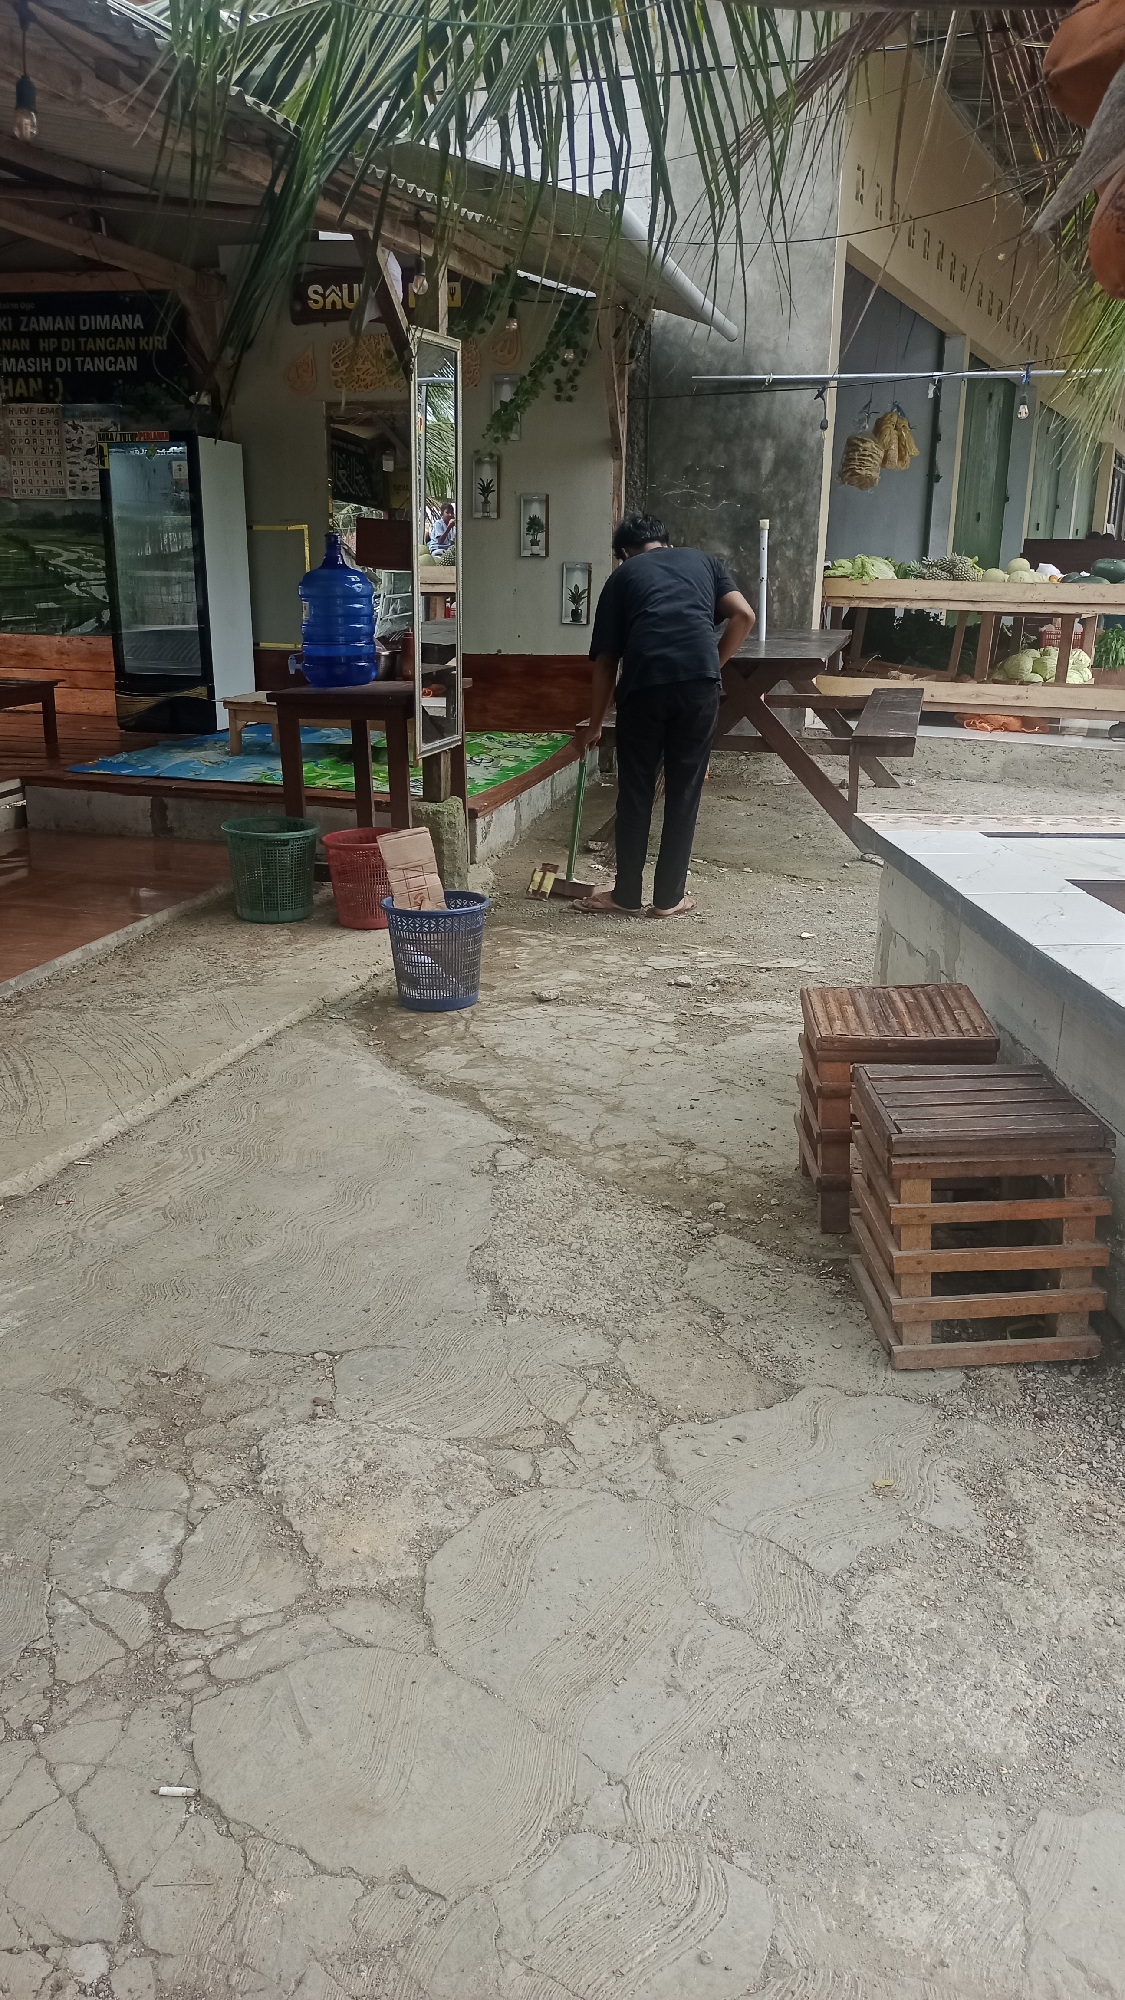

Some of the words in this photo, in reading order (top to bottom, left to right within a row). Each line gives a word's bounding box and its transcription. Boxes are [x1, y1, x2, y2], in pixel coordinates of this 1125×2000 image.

[20, 315, 75, 331] ZAMAN
[79, 314, 144, 330] DIMANA
[39, 338, 58, 351] HP
[62, 337, 76, 351] DI
[78, 336, 136, 351] TANGAN
[139, 336, 168, 350] KIRI
[2, 357, 52, 373] MASIH
[55, 357, 72, 372] DI
[75, 356, 138, 372] TANGAN
